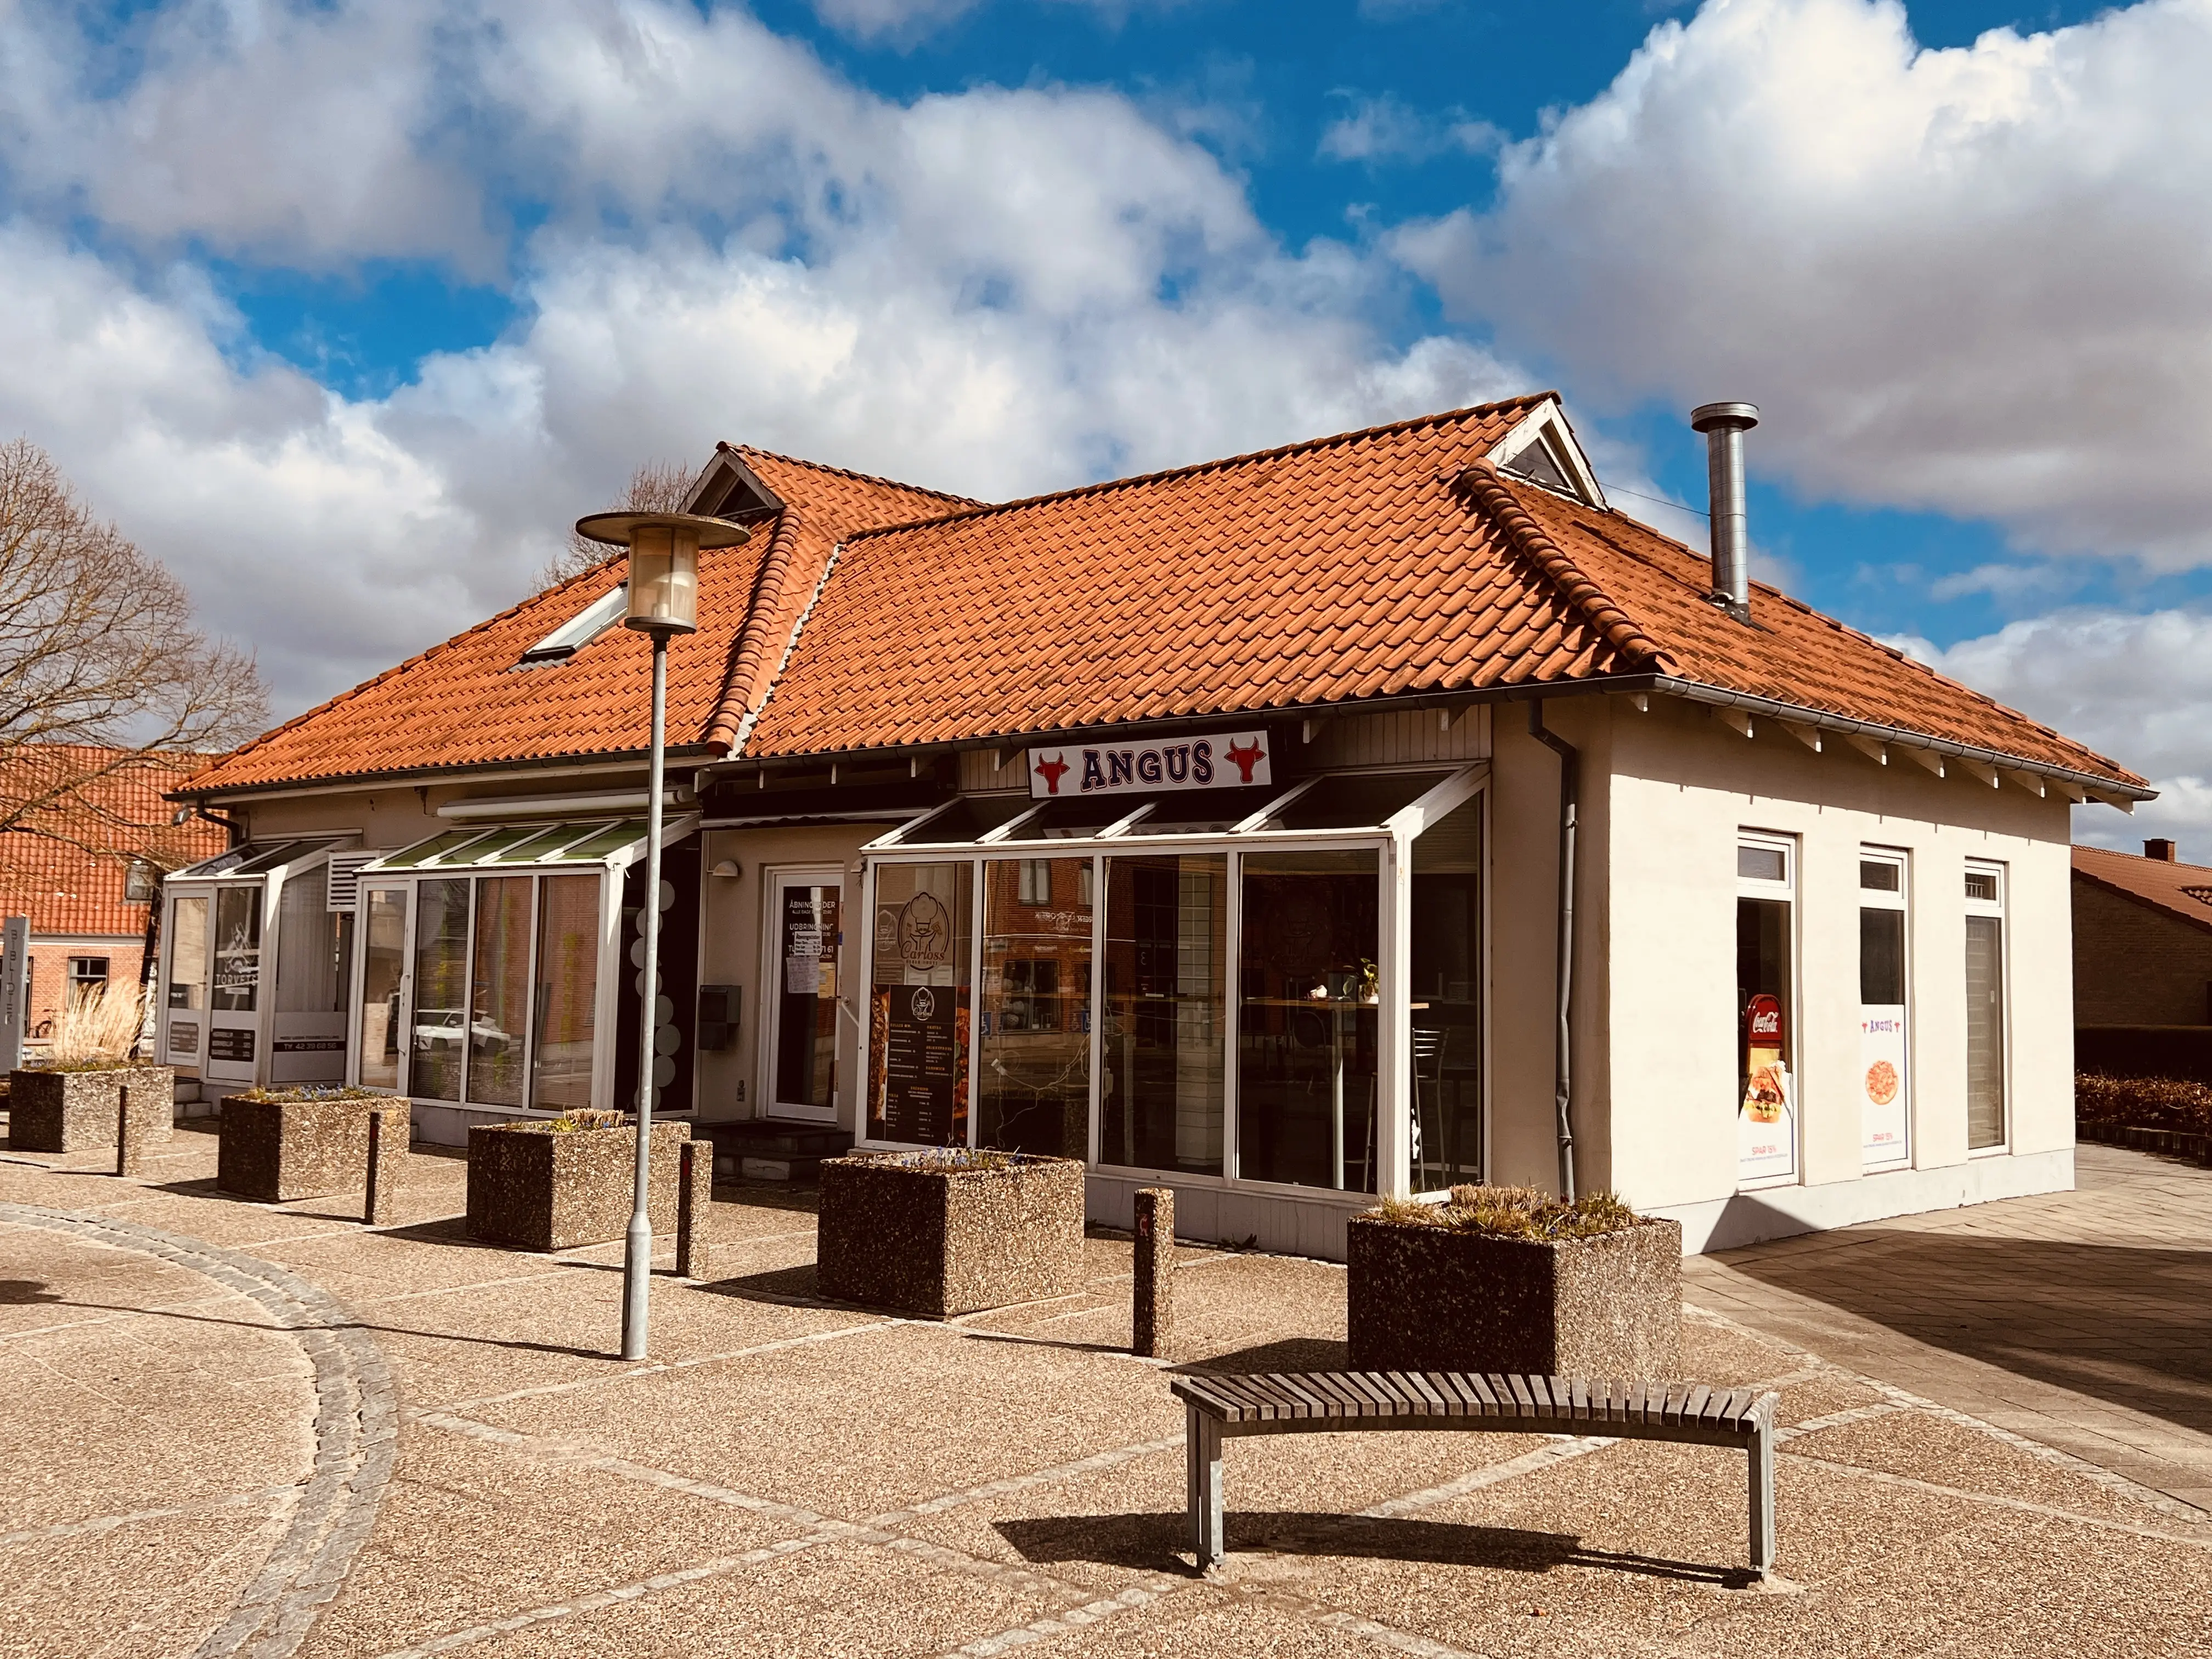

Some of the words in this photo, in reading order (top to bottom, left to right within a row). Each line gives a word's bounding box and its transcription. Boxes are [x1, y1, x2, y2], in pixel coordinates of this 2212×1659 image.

[1080, 740, 1214, 793] ANGUS
[900, 940, 944, 961] Carloss
[1870, 1020, 1892, 1033] ANGUS
